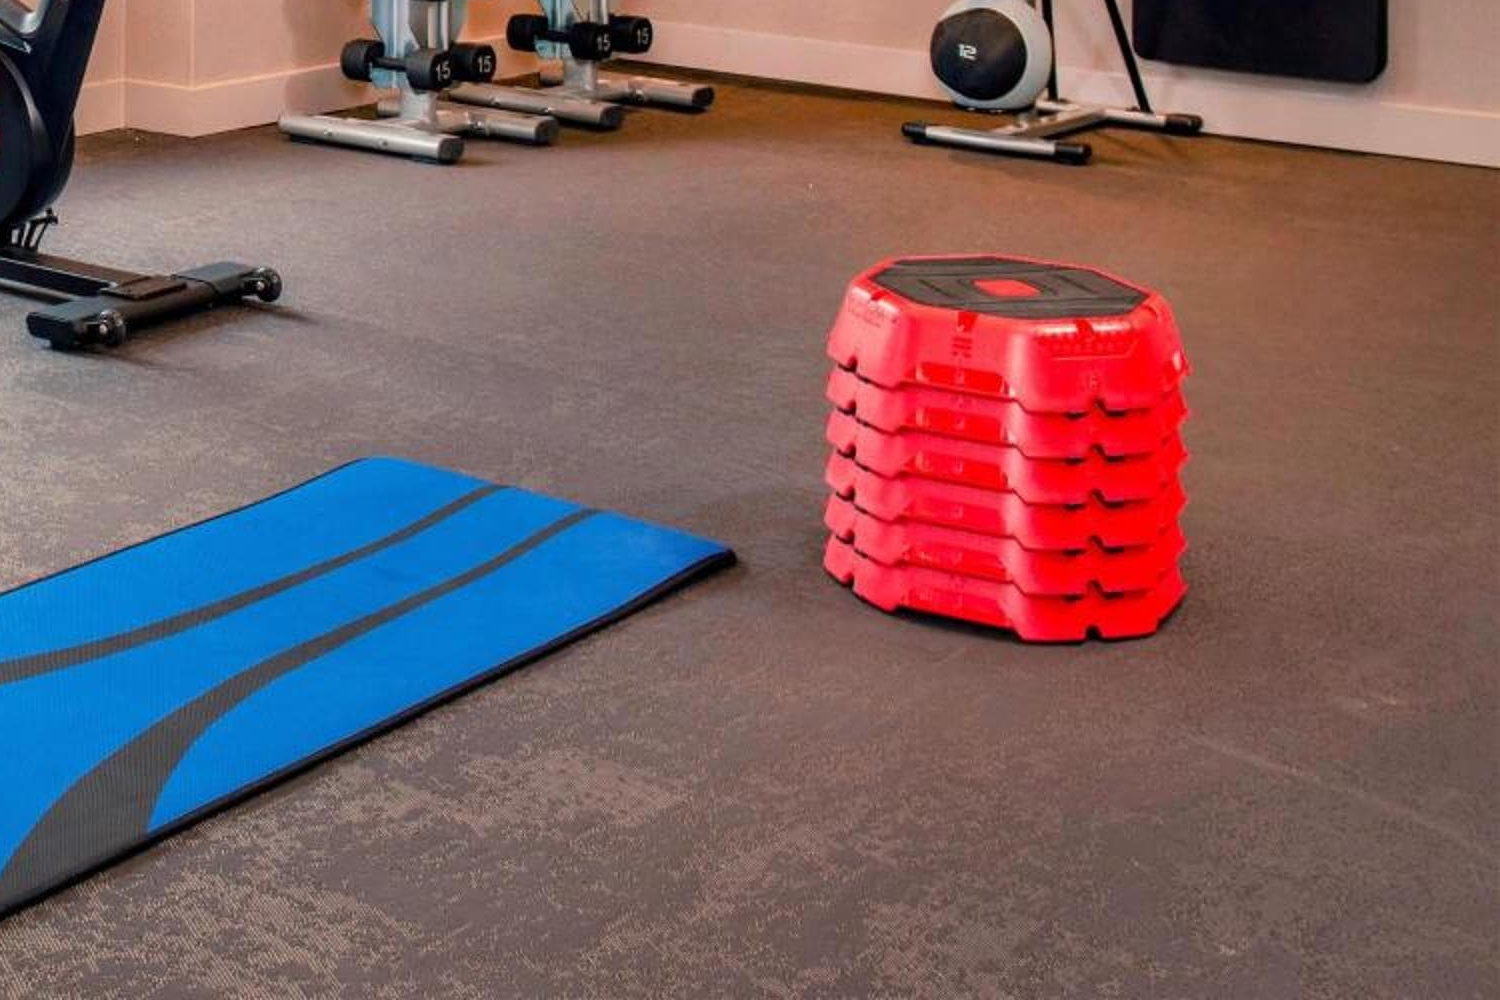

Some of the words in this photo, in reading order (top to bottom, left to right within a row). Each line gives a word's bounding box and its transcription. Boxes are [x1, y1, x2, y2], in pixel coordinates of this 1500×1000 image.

[596, 34, 611, 51] 15
[637, 28, 649, 45] 15
[958, 43, 977, 61] 12
[436, 62, 450, 82] 15
[477, 55, 492, 74] 15
